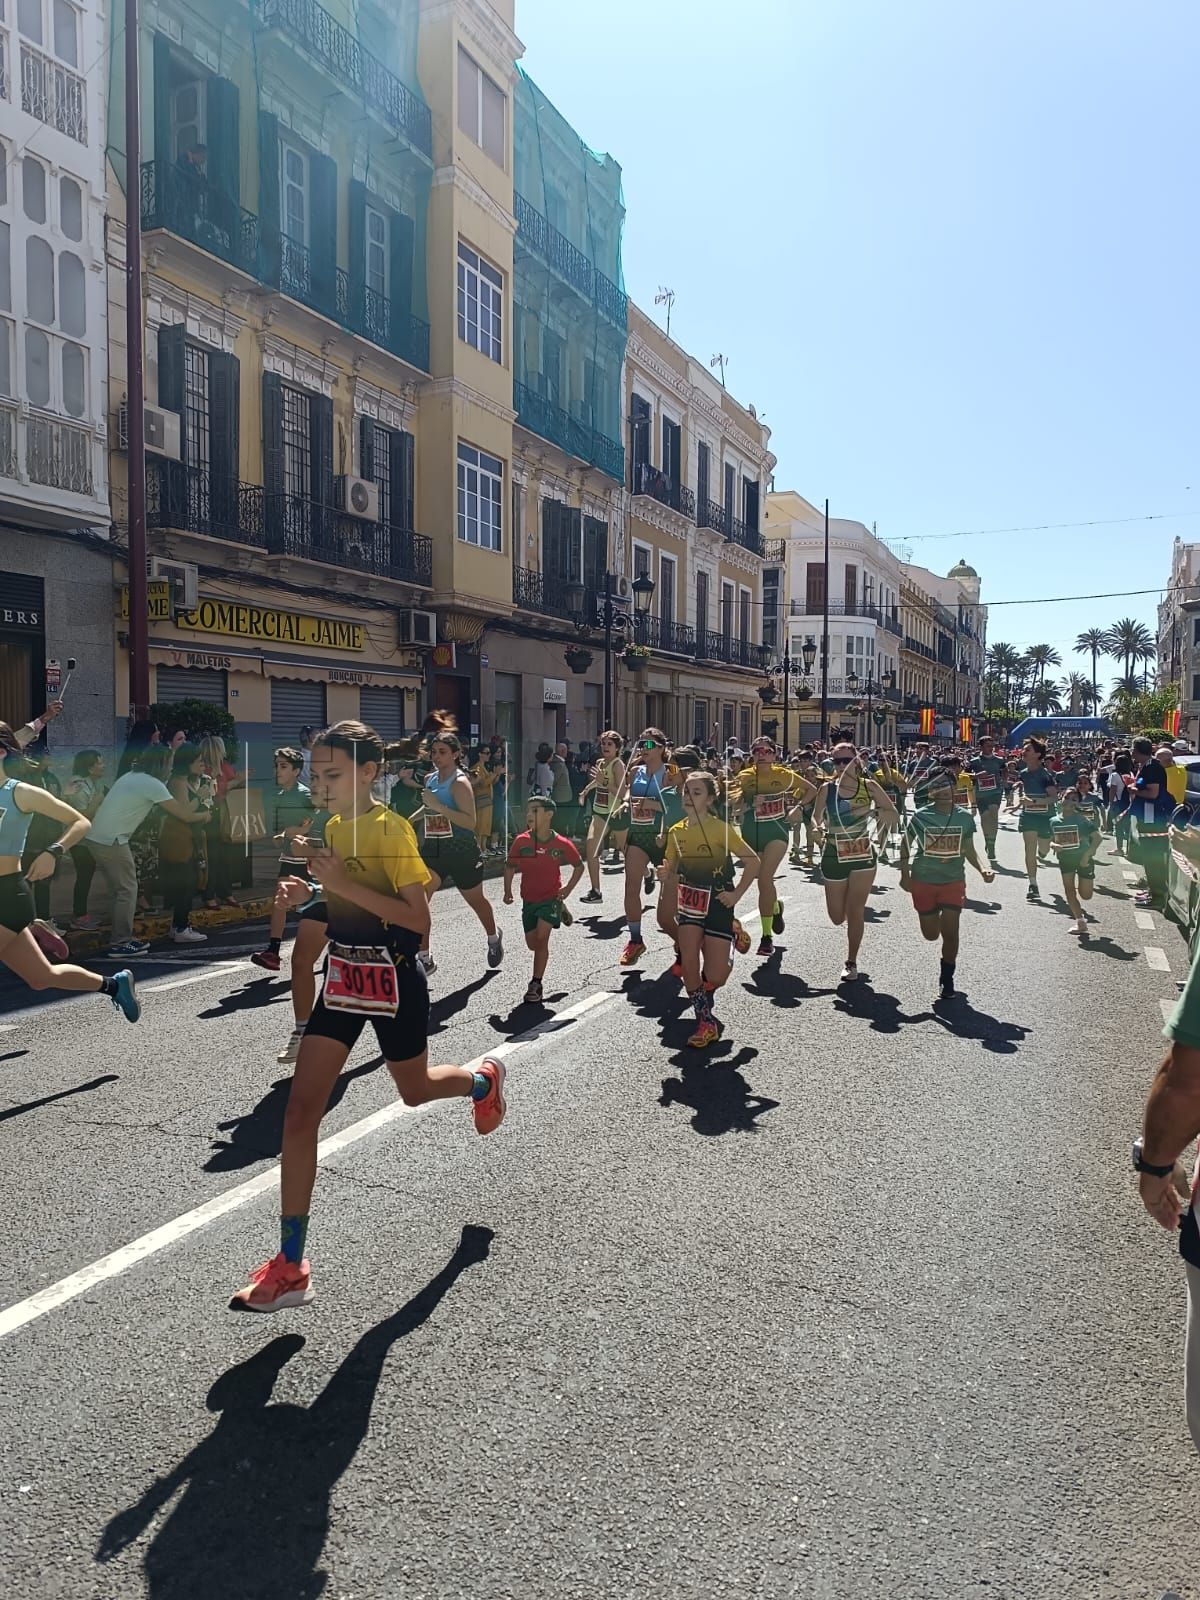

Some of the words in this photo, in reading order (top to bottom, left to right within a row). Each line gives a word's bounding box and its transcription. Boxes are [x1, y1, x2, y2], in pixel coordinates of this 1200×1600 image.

[3, 609, 38, 625] ERS
[311, 619, 362, 649] JAIME
[186, 652, 232, 668] MALETAS
[230, 811, 267, 838] ZARA
[342, 963, 393, 996] 3016
